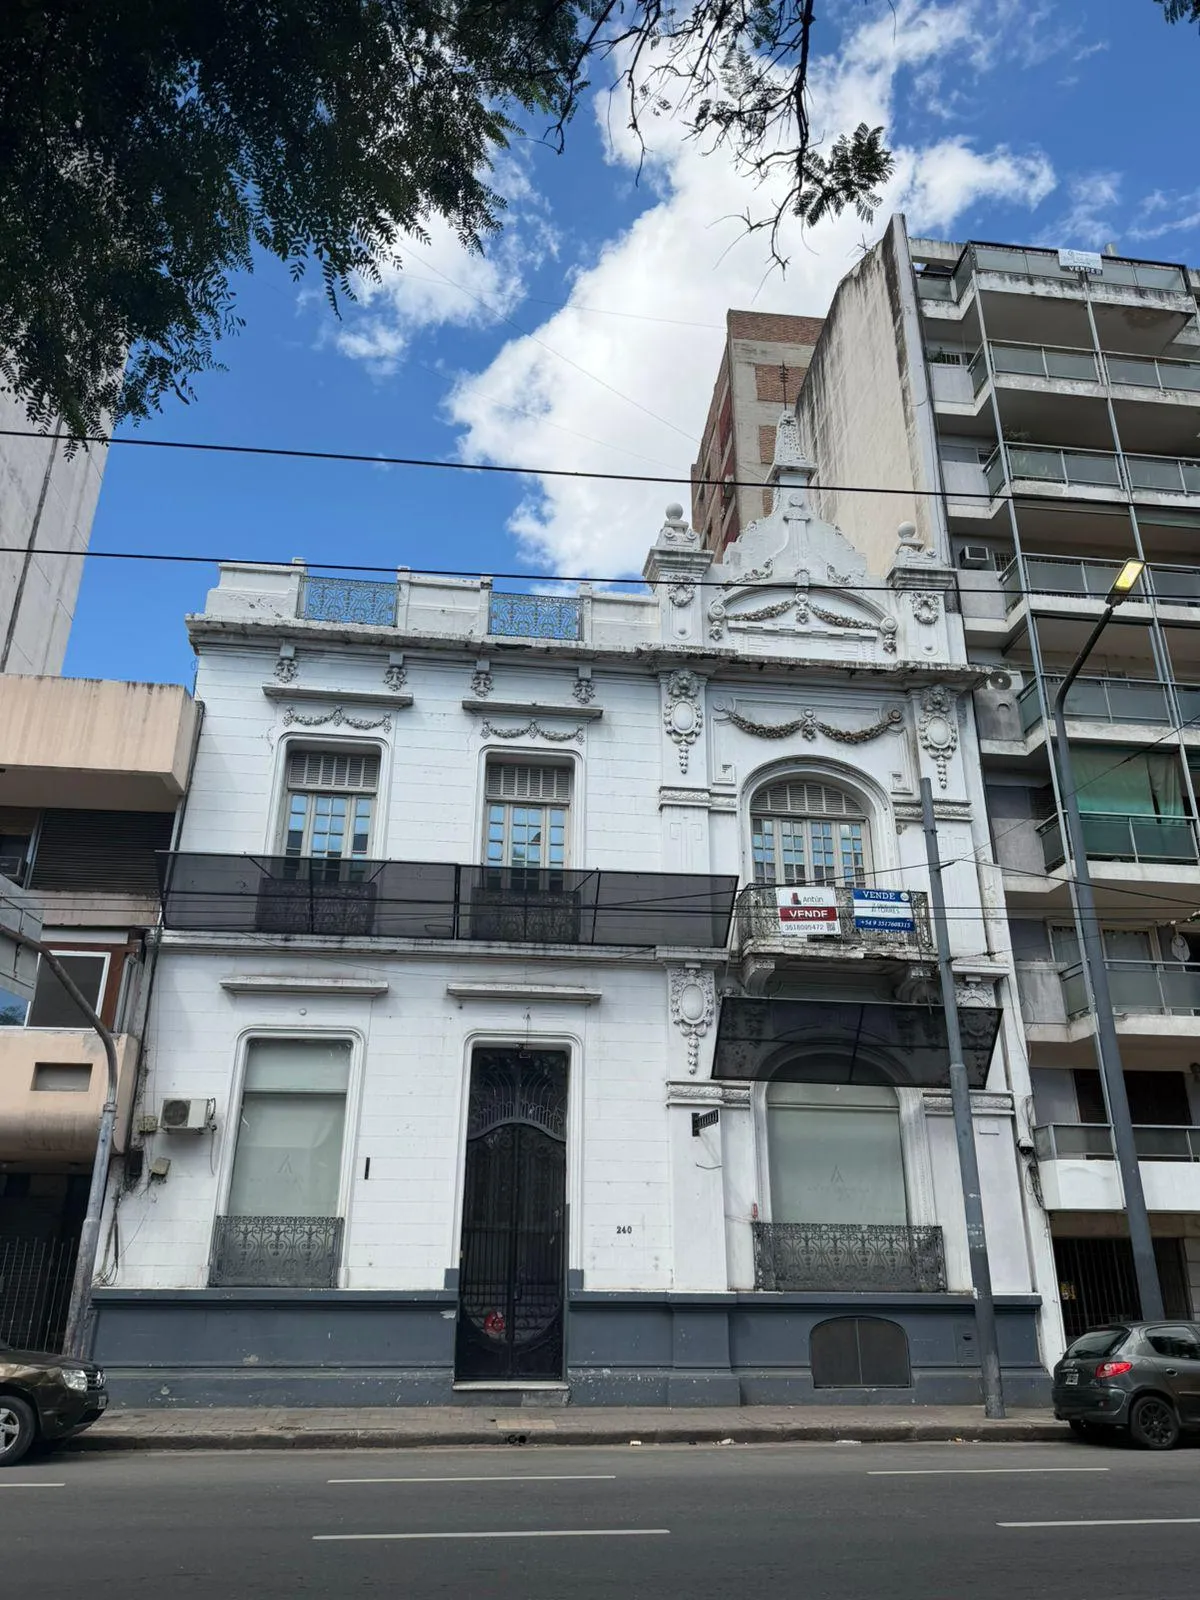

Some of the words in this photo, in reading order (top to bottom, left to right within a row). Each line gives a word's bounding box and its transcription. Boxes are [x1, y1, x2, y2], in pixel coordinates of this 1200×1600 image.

[863, 891, 896, 900] VENDE
[789, 910, 828, 918] VENDE
[616, 1225, 633, 1234] 240
